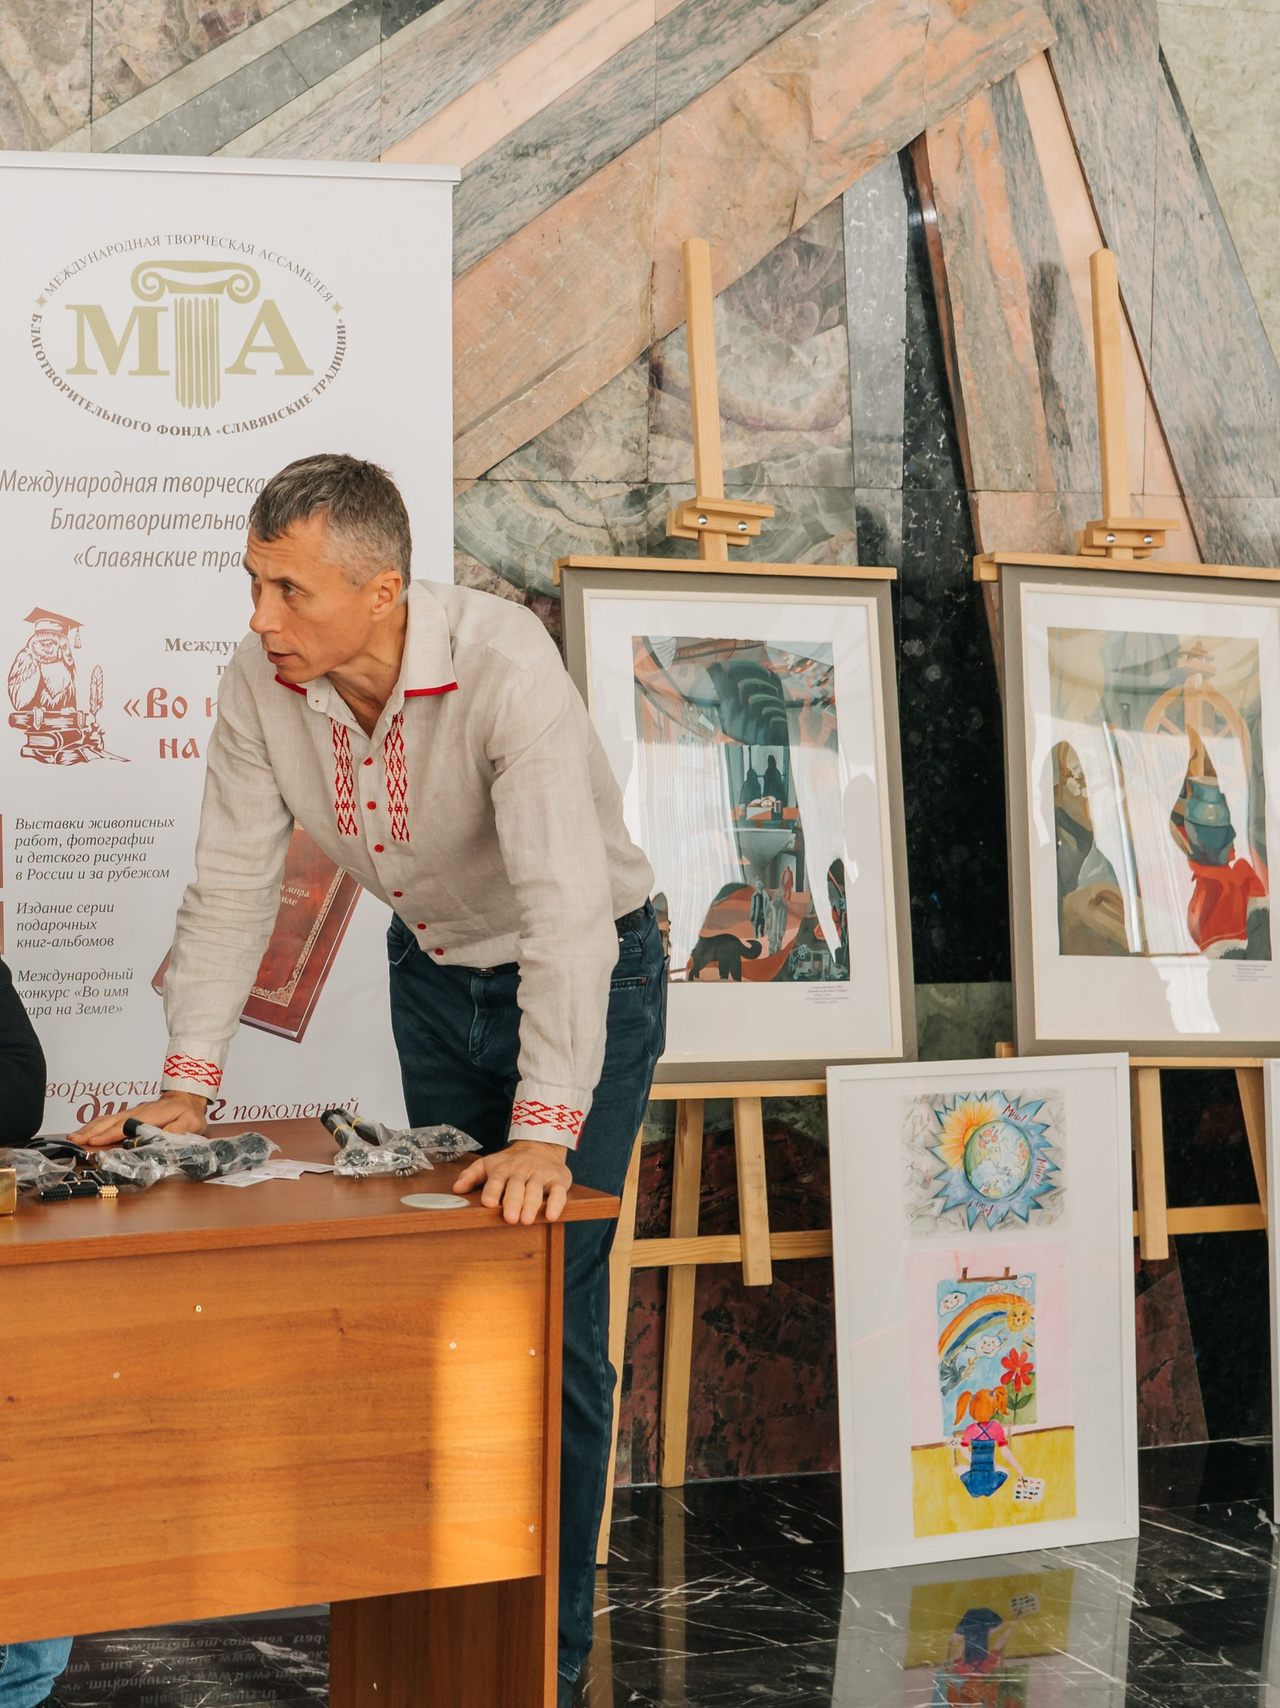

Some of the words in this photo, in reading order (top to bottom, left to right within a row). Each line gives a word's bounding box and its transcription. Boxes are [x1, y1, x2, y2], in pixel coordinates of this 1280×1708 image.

[44, 235, 160, 296] МЕЖДУНАРОДНАЯ
[165, 233, 255, 255] ТВОРЧЕСКАЯ
[258, 249, 333, 302] АССАМБЛЕЯ
[30, 313, 152, 433] БЛАГОТВОРИТЕЛЬНОГО
[156, 424, 211, 438] ФОНДА
[163, 475, 268, 498] творческа
[74, 545, 197, 567] «Славянские
[201, 548, 247, 573] тра
[124, 687, 187, 719] «Во
[159, 738, 200, 759] на
[15, 818, 84, 830] Выставки
[88, 818, 175, 829] живописных
[15, 834, 62, 849] работ,
[67, 833, 155, 849] фотографии
[15, 854, 23, 863] и
[27, 851, 90, 864] детского
[93, 852, 146, 865] рисунка
[15, 870, 23, 880] в
[27, 868, 73, 880] России
[78, 870, 85, 879] и
[89, 870, 103, 879] за
[107, 867, 170, 882] рубежом
[16, 902, 72, 914] Издание
[77, 904, 114, 916] серии
[16, 919, 97, 933] подарочных
[16, 935, 114, 948] книг-альбомов
[17, 968, 133, 984] Международный
[18, 988, 70, 1001] конкурс
[74, 986, 99, 998] «Во
[104, 987, 129, 998] имя
[25, 1006, 52, 1018] ира
[56, 1006, 71, 1015] на
[76, 1003, 123, 1015] Земле»
[46, 1080, 162, 1104] ворчески
